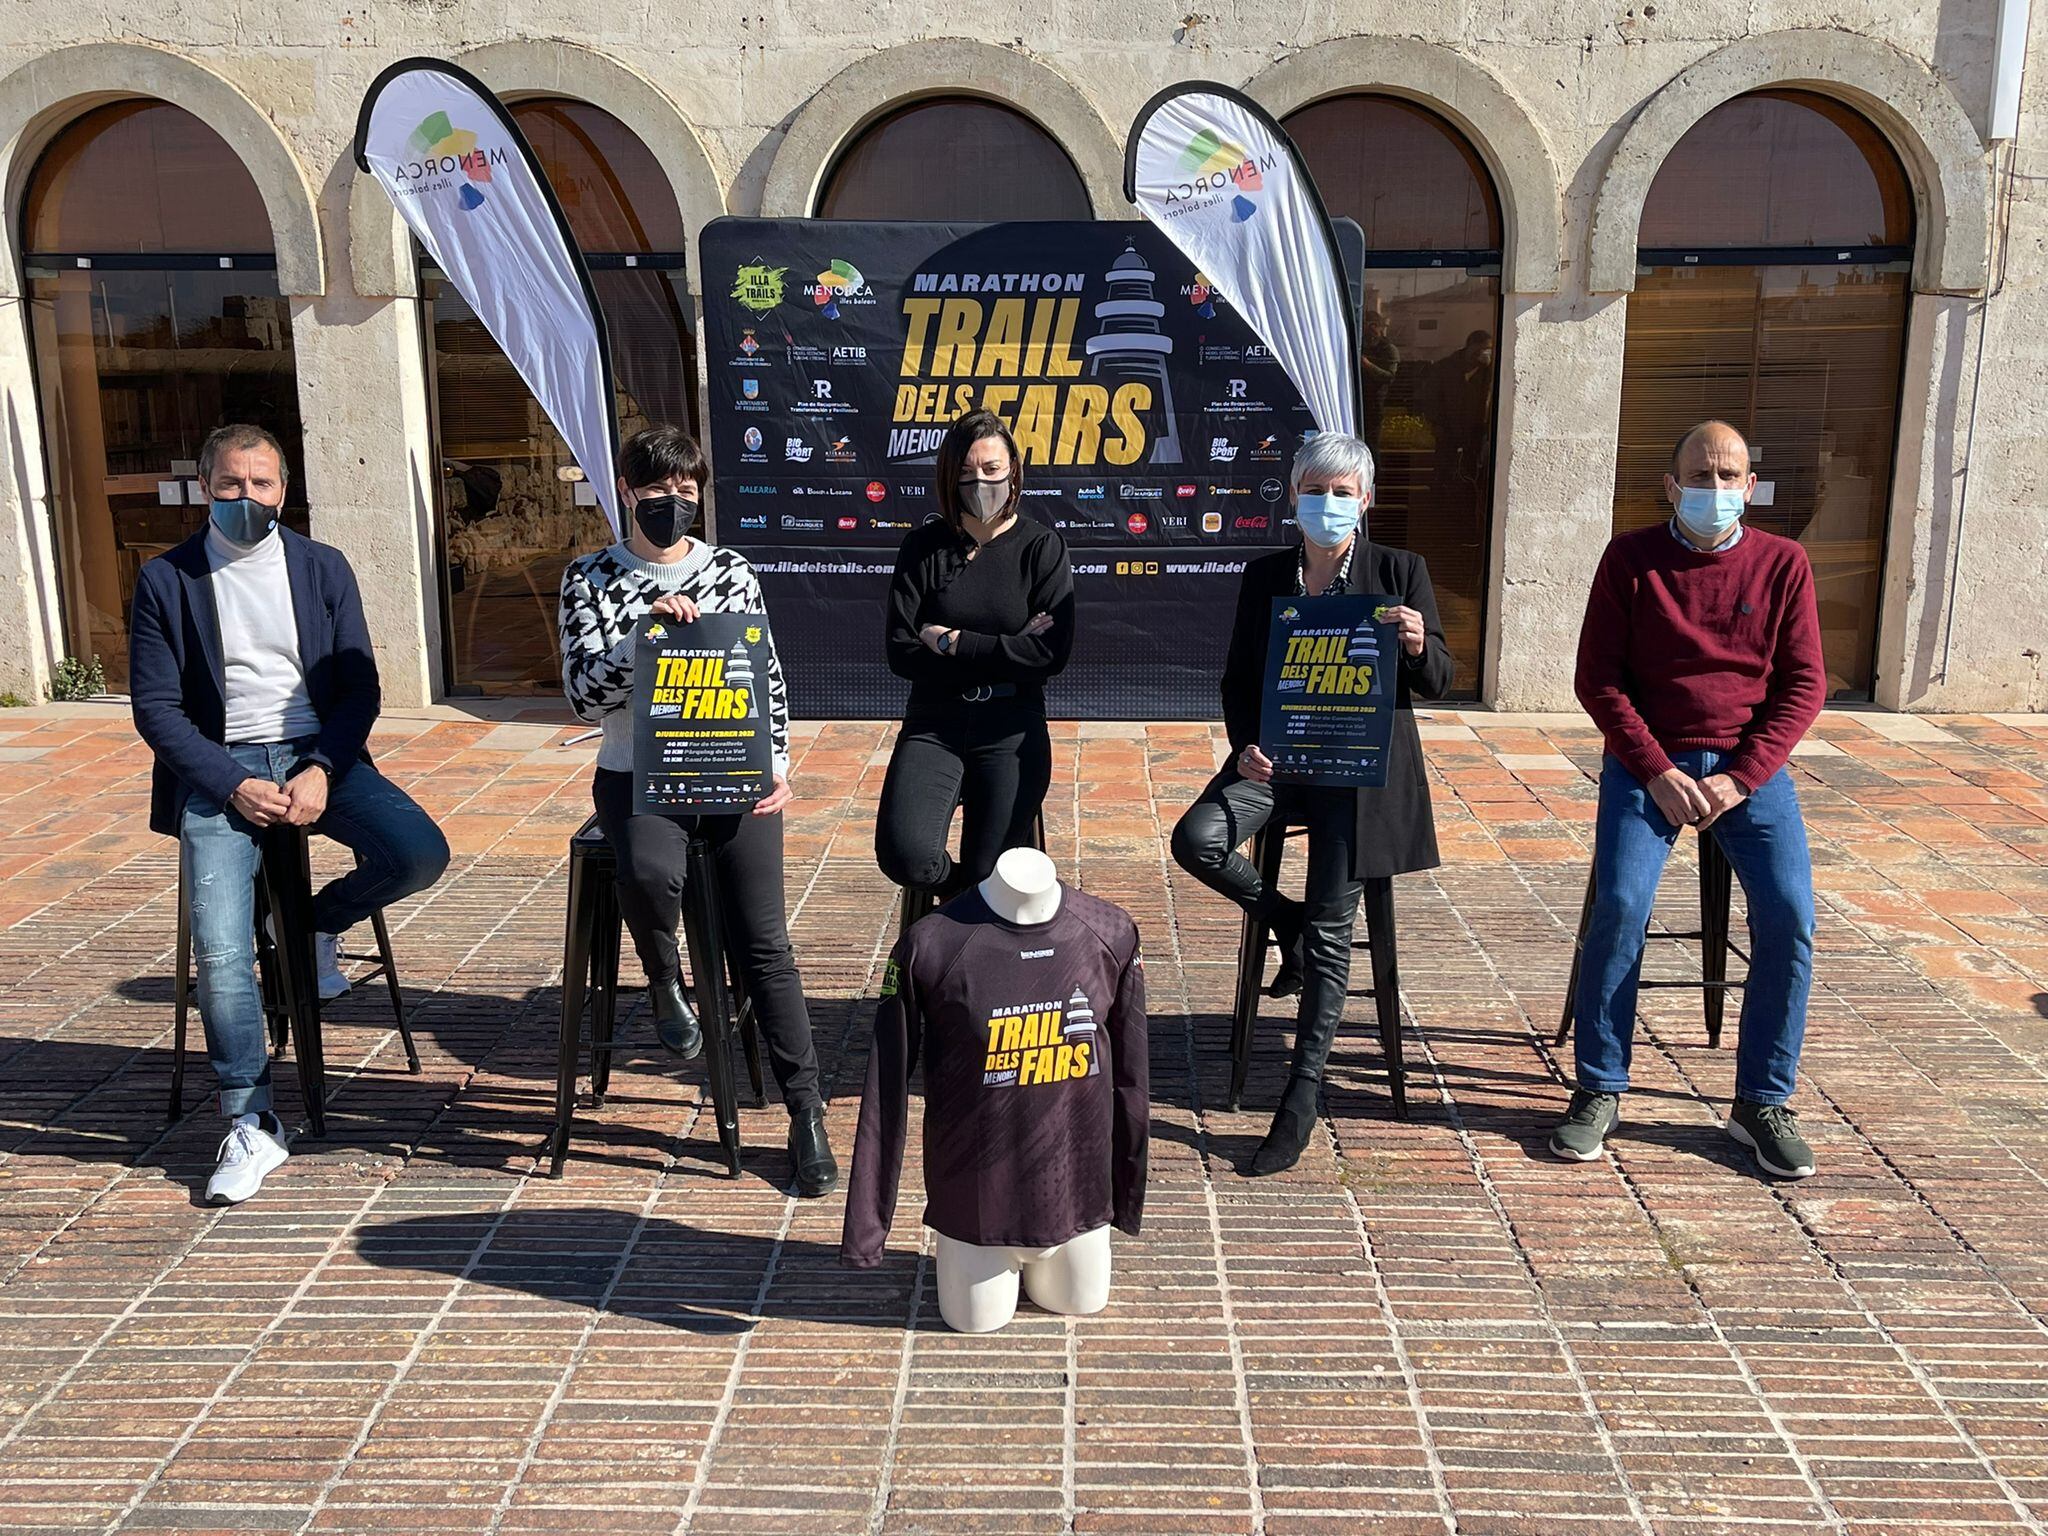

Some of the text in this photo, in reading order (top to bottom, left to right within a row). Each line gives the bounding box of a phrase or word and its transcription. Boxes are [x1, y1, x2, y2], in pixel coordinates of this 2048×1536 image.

[750, 275, 769, 286] ILLA
[913, 273, 1085, 292] MARATHON
[746, 288, 776, 299] TRAILS
[803, 285, 874, 296] MENORCA
[1180, 284, 1220, 295] MENO
[900, 297, 1083, 377] TRAIL
[832, 346, 867, 358] AETIB
[1246, 345, 1271, 356] AETI
[892, 384, 974, 422] DELS
[887, 428, 948, 458] MENO
[785, 447, 813, 458] SPORT
[1210, 447, 1239, 457] SPORT
[900, 486, 925, 496] VERI
[1162, 517, 1187, 526] VERI
[752, 561, 895, 574] ww.illadelstrails.com
[1292, 628, 1349, 636] MARATHON
[661, 649, 725, 657] MARATHON
[1285, 636, 1348, 663] TRAIL
[655, 657, 725, 687] TRAIL
[1277, 680, 1306, 691] MENORCA
[1281, 664, 1372, 695] DELS FARS
[652, 688, 749, 719] DELS FARS
[650, 705, 682, 716] MENORCA
[992, 1001, 1062, 1017] MARATHON
[987, 1011, 1063, 1053] TRAIL
[985, 1043, 1090, 1086] DELS FARS
[983, 1069, 1017, 1085] MENORCA
